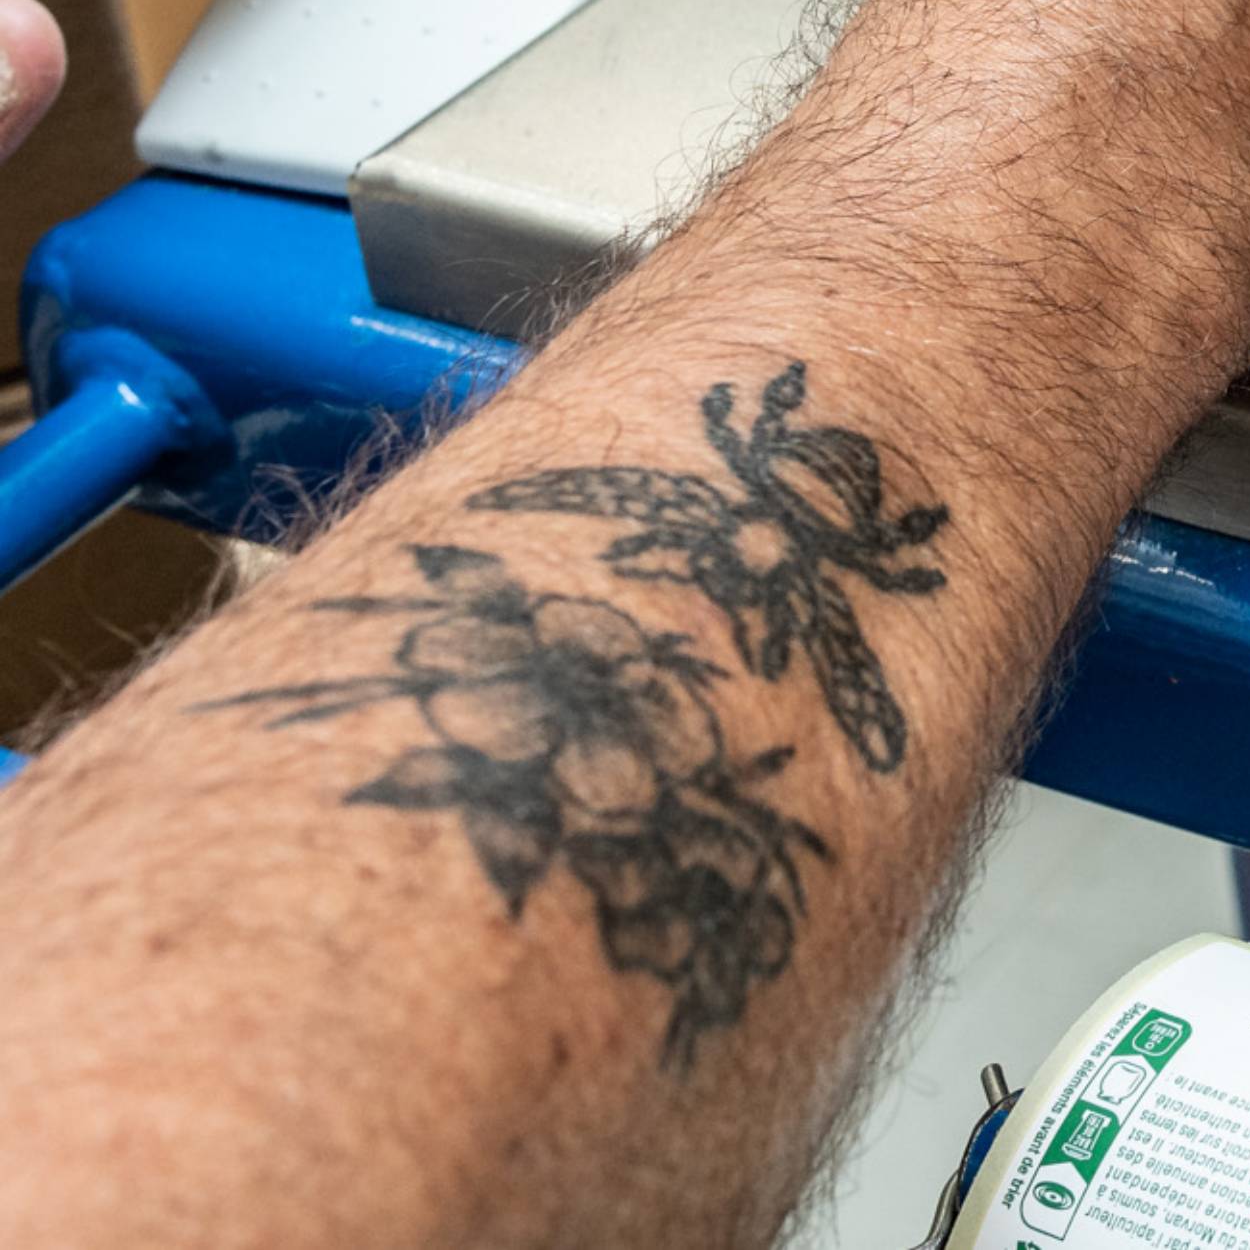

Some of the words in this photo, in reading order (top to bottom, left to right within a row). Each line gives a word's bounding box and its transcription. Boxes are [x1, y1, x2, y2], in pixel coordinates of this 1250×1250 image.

[1106, 1002, 1147, 1040] Séparez
[1090, 1037, 1112, 1058] les
[1051, 1059, 1095, 1112] éléments
[1174, 1076, 1188, 1089] le
[1188, 1081, 1227, 1101] avant
[1140, 1110, 1178, 1134] terres
[1178, 1124, 1200, 1142] les
[1028, 1117, 1055, 1154] avant
[1127, 1127, 1152, 1145] est
[1199, 1134, 1222, 1149] sur
[1017, 1157, 1033, 1175] de
[1117, 1145, 1144, 1166] des
[1169, 1145, 1248, 1181] producteur.
[1146, 1157, 1208, 1189] annuelle
[1002, 1178, 1024, 1209] trier
[1105, 1165, 1202, 1210] indépendant
[1108, 1189, 1158, 1218] soumis
[1084, 1206, 1163, 1248] l'apiculteur
[1163, 1208, 1216, 1244] Morvan,
[1217, 1231, 1237, 1250] du
